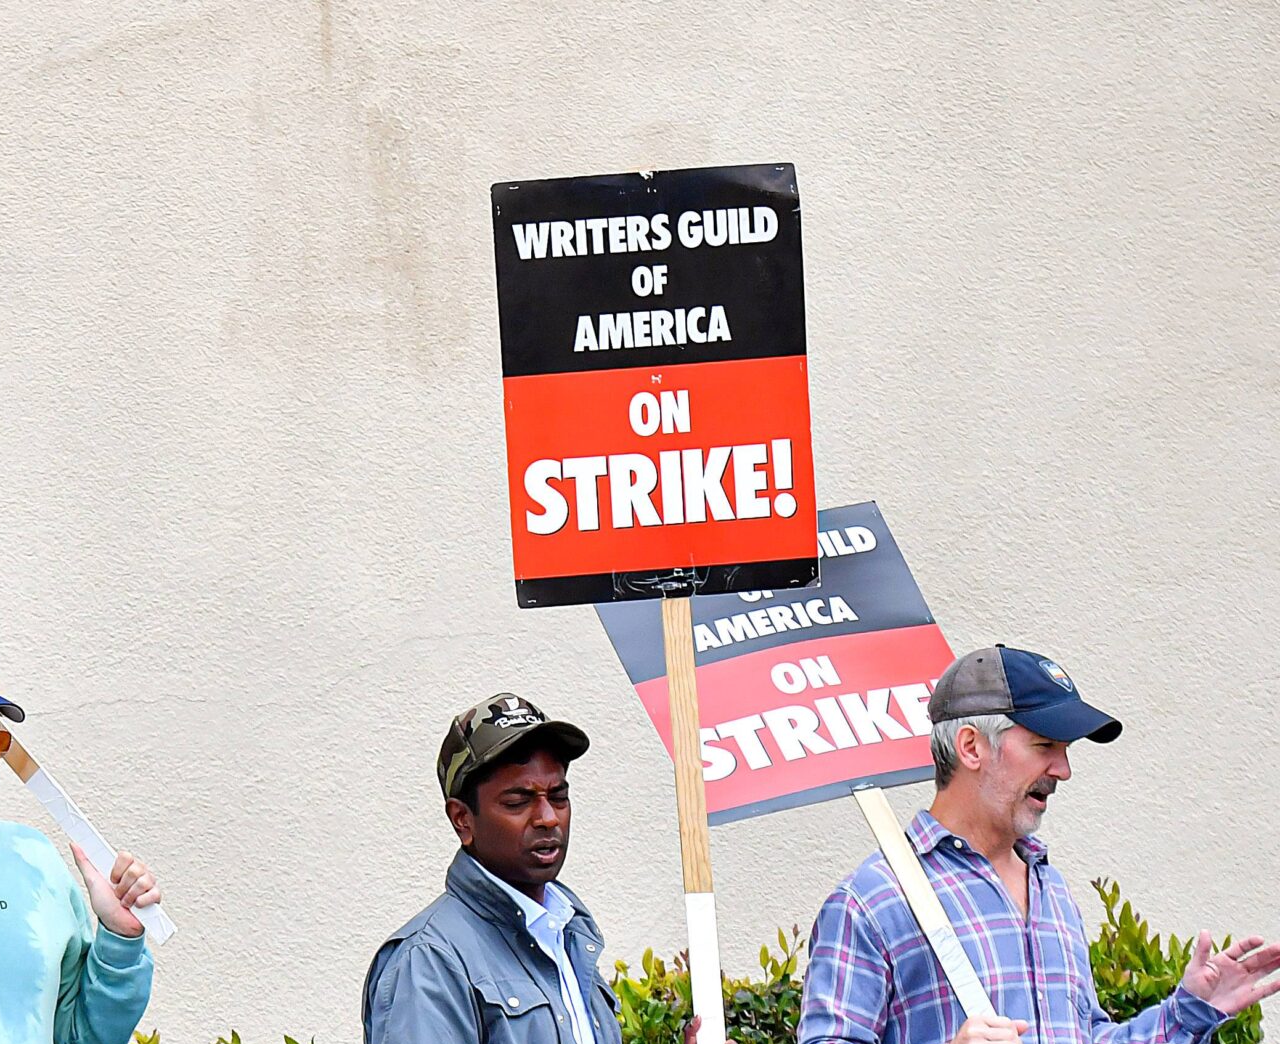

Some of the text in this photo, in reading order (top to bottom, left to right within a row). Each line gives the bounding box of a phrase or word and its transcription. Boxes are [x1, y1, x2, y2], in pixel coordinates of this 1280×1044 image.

[511, 206, 779, 260] WRITERS GUILD
[631, 264, 668, 297] OF
[573, 305, 732, 352] AMERICA
[628, 389, 691, 437] ON
[523, 438, 800, 535] STRIKE!
[817, 526, 877, 558] ILD
[693, 596, 859, 653] AMERICA
[770, 655, 842, 695] ON
[699, 678, 939, 782] STRIKE
